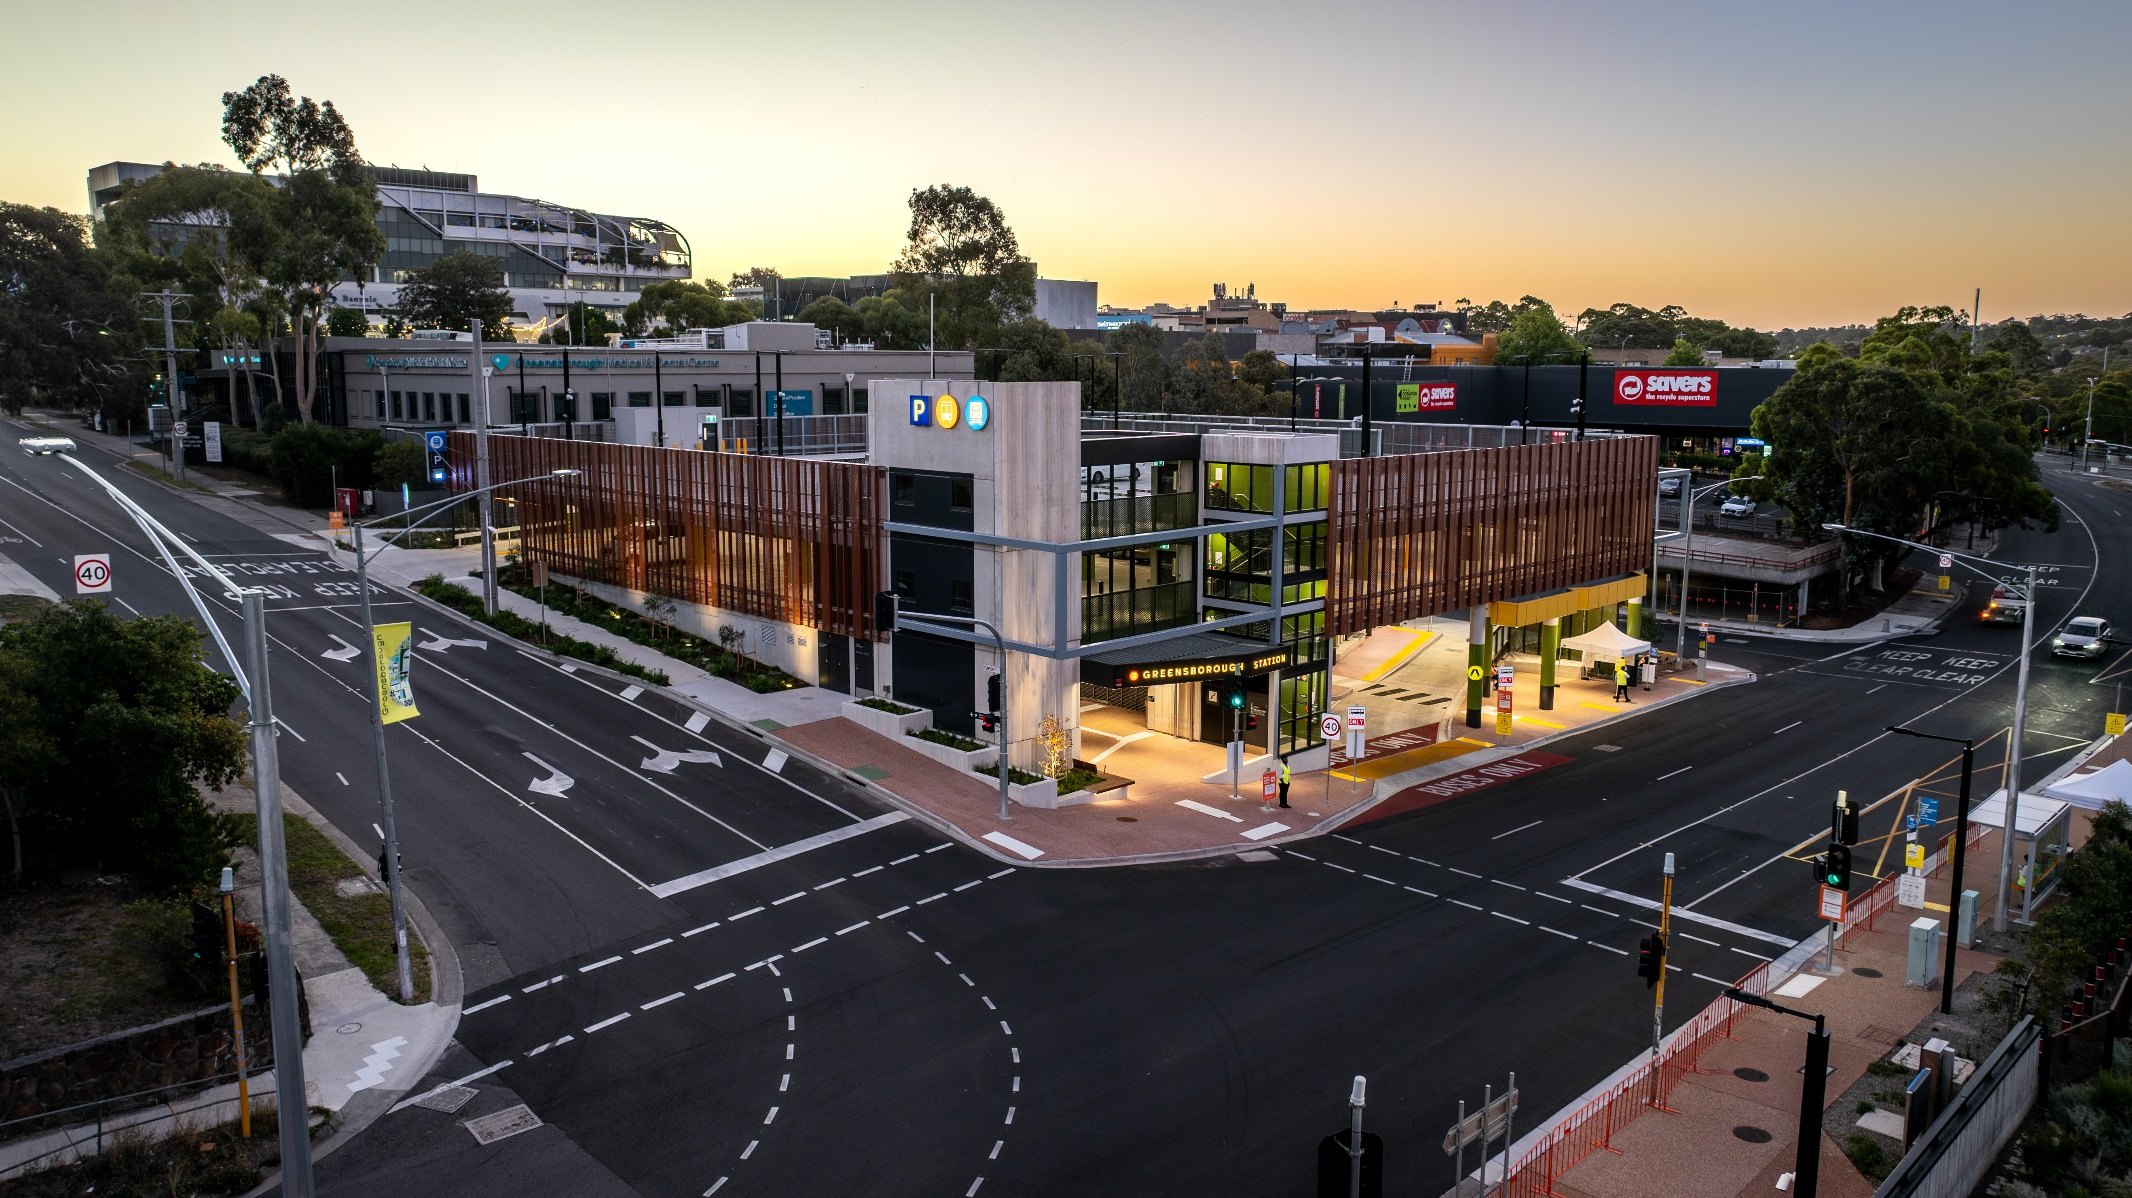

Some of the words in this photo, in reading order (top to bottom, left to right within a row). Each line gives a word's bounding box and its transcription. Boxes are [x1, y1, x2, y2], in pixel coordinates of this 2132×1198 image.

[342, 295, 377, 304] Banyule
[515, 357, 600, 370] Greensbrough
[1646, 376, 1712, 392] savers
[1431, 387, 1454, 399] savers
[1656, 393, 1676, 401] recycle
[1677, 394, 1710, 402] superstore
[914, 399, 926, 422] P
[434, 455, 442, 465] P
[81, 566, 105, 580] 40
[223, 584, 302, 601] KEP
[1142, 662, 1245, 680] GREENSBOROUGH
[1253, 653, 1287, 670] STATION
[1876, 649, 1933, 662] KEEP
[1941, 656, 2000, 670] KEEP
[376, 634, 389, 716] Greensborough
[1843, 661, 1914, 676] CLEAR
[1912, 669, 1985, 685] CLEAR
[1325, 722, 1338, 732] 40
[1348, 718, 1364, 726] ONLY
[1416, 774, 1496, 797] BUSES
[1478, 758, 1543, 778] ONLY
